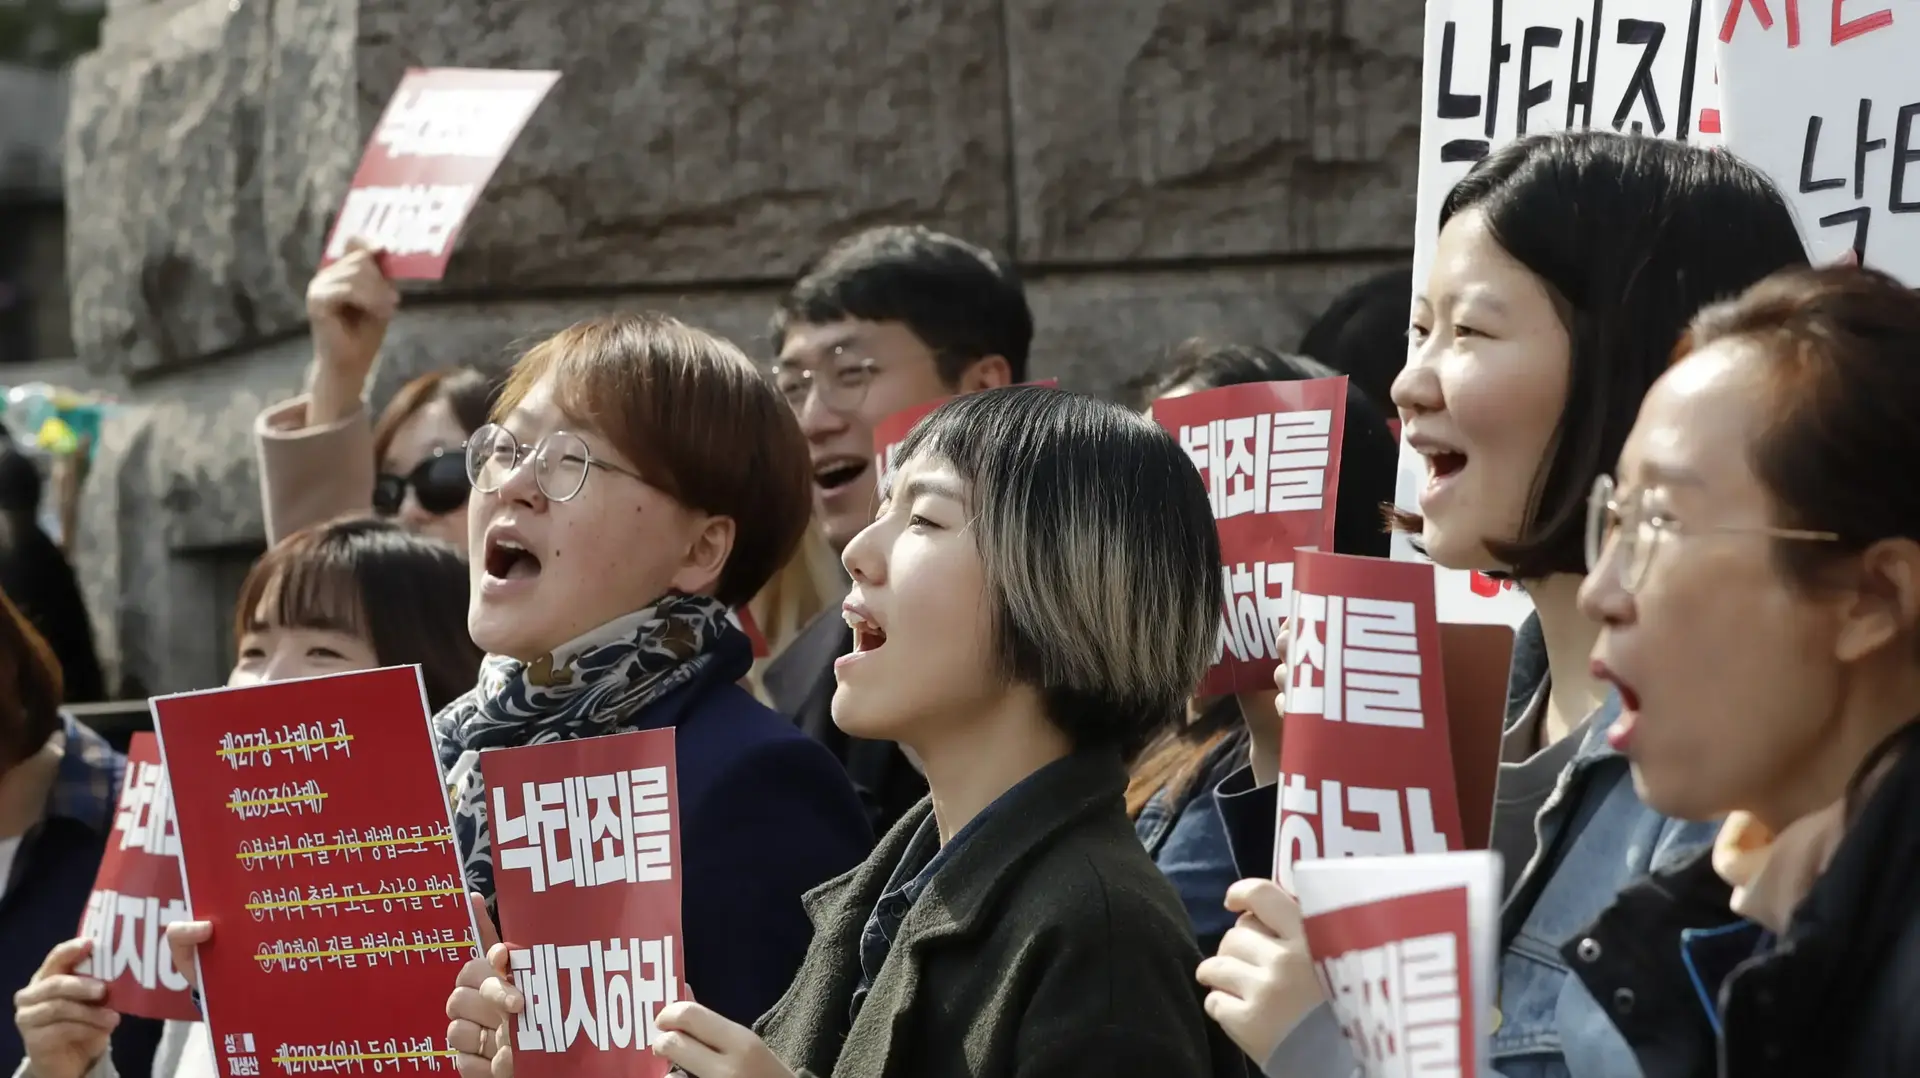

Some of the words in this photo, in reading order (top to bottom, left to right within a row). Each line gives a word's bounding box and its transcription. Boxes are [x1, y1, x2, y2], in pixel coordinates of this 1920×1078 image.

[219, 728, 272, 771] 제27장
[331, 718, 351, 758] 죄
[298, 832, 330, 866] 약물
[332, 828, 363, 863] 기타
[364, 825, 428, 861] 방법으로
[492, 766, 672, 892] 낙태죄를
[307, 883, 338, 918] 촉탁
[342, 880, 375, 914] 또는
[378, 877, 423, 914] 승낙을
[325, 935, 357, 970] 죄를
[360, 930, 409, 967] 범하여
[411, 926, 460, 964] 부녀를
[509, 935, 678, 1053] 폐지하라
[367, 1037, 401, 1073] 등의
